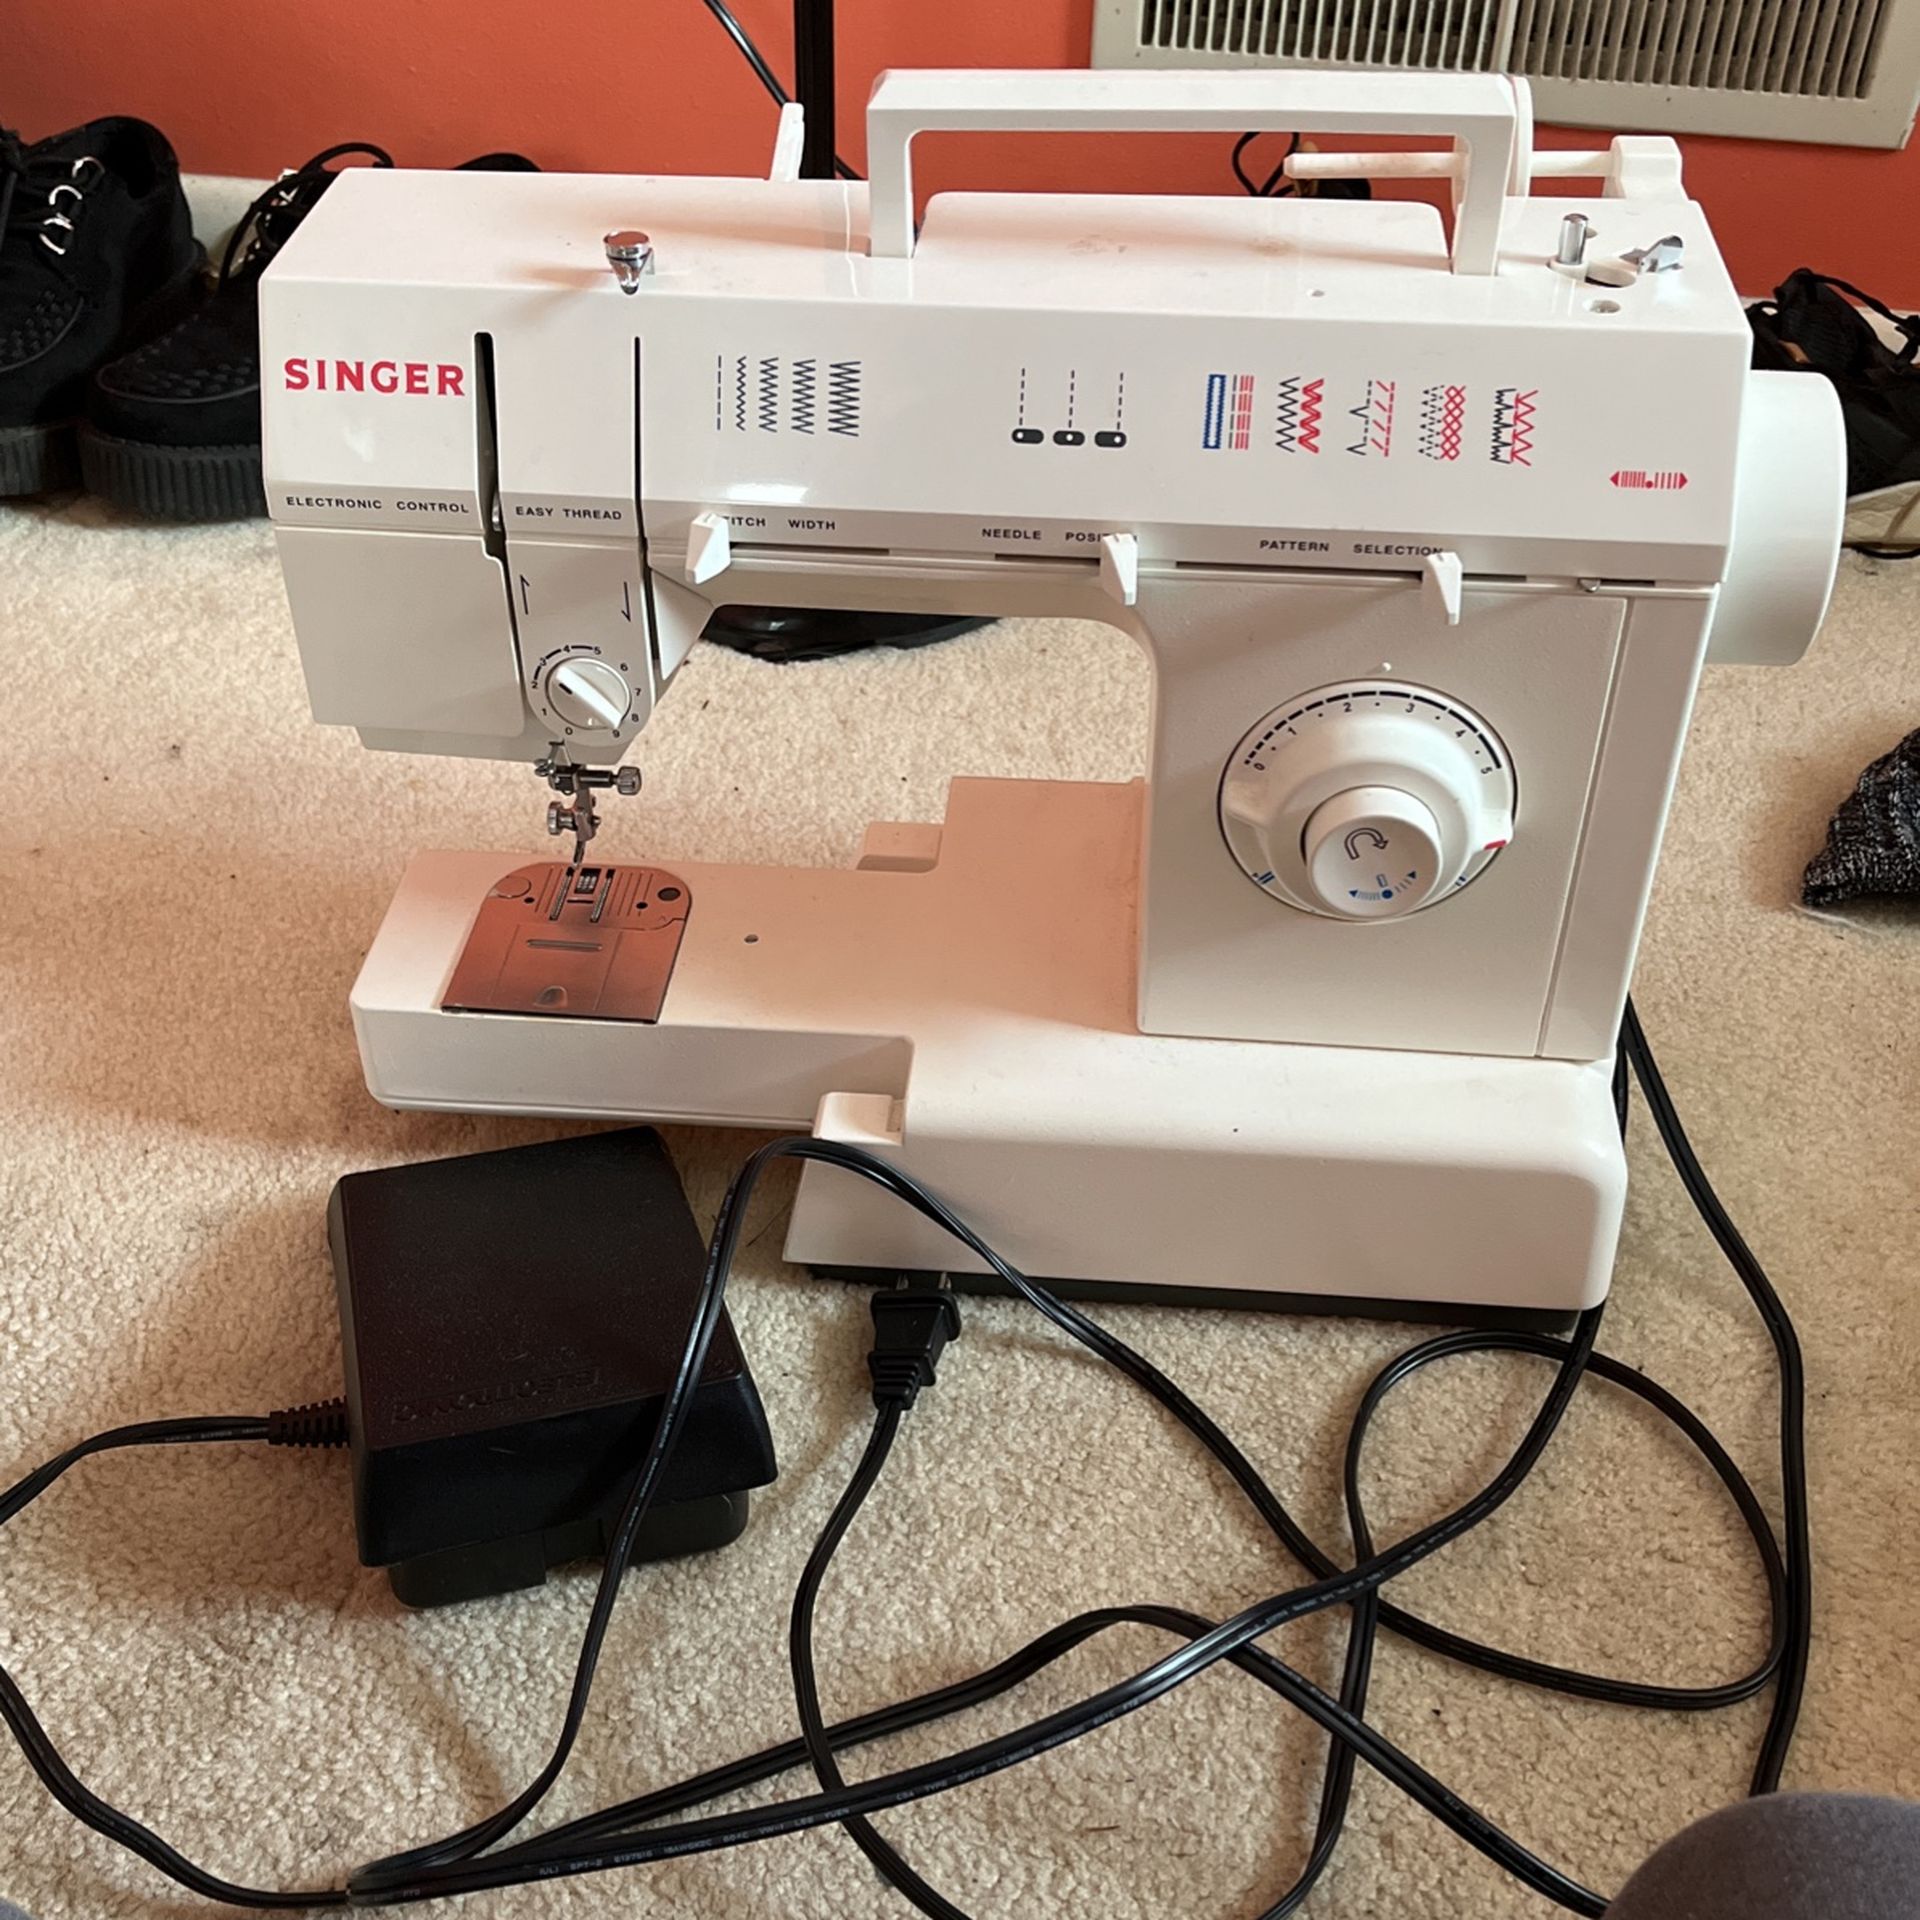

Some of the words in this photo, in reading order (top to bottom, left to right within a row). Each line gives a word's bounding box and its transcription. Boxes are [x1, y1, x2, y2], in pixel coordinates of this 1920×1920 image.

[284, 358, 465, 397] SINGER
[286, 496, 382, 509] ELECTRONIC
[396, 501, 469, 513] CONTROL
[516, 506, 553, 517] EASY
[563, 508, 622, 520] THREAD
[721, 515, 766, 527] ITCH
[788, 519, 835, 530] WIDTH
[982, 528, 1042, 540] NEEDLE
[1260, 539, 1330, 552] PATTERN
[563, 644, 571, 653] 4
[594, 646, 602, 655] 5
[540, 657, 547, 667] 3
[620, 662, 628, 671] 6
[531, 681, 538, 689] 2
[635, 687, 642, 696] 7
[541, 707, 547, 716] 1
[631, 713, 639, 722] 8
[612, 729, 620, 738] 9
[1287, 727, 1297, 737] 1
[1343, 702, 1352, 713] 2
[1405, 702, 1415, 713] 3
[1455, 727, 1466, 739] 4
[1481, 765, 1493, 775] 5
